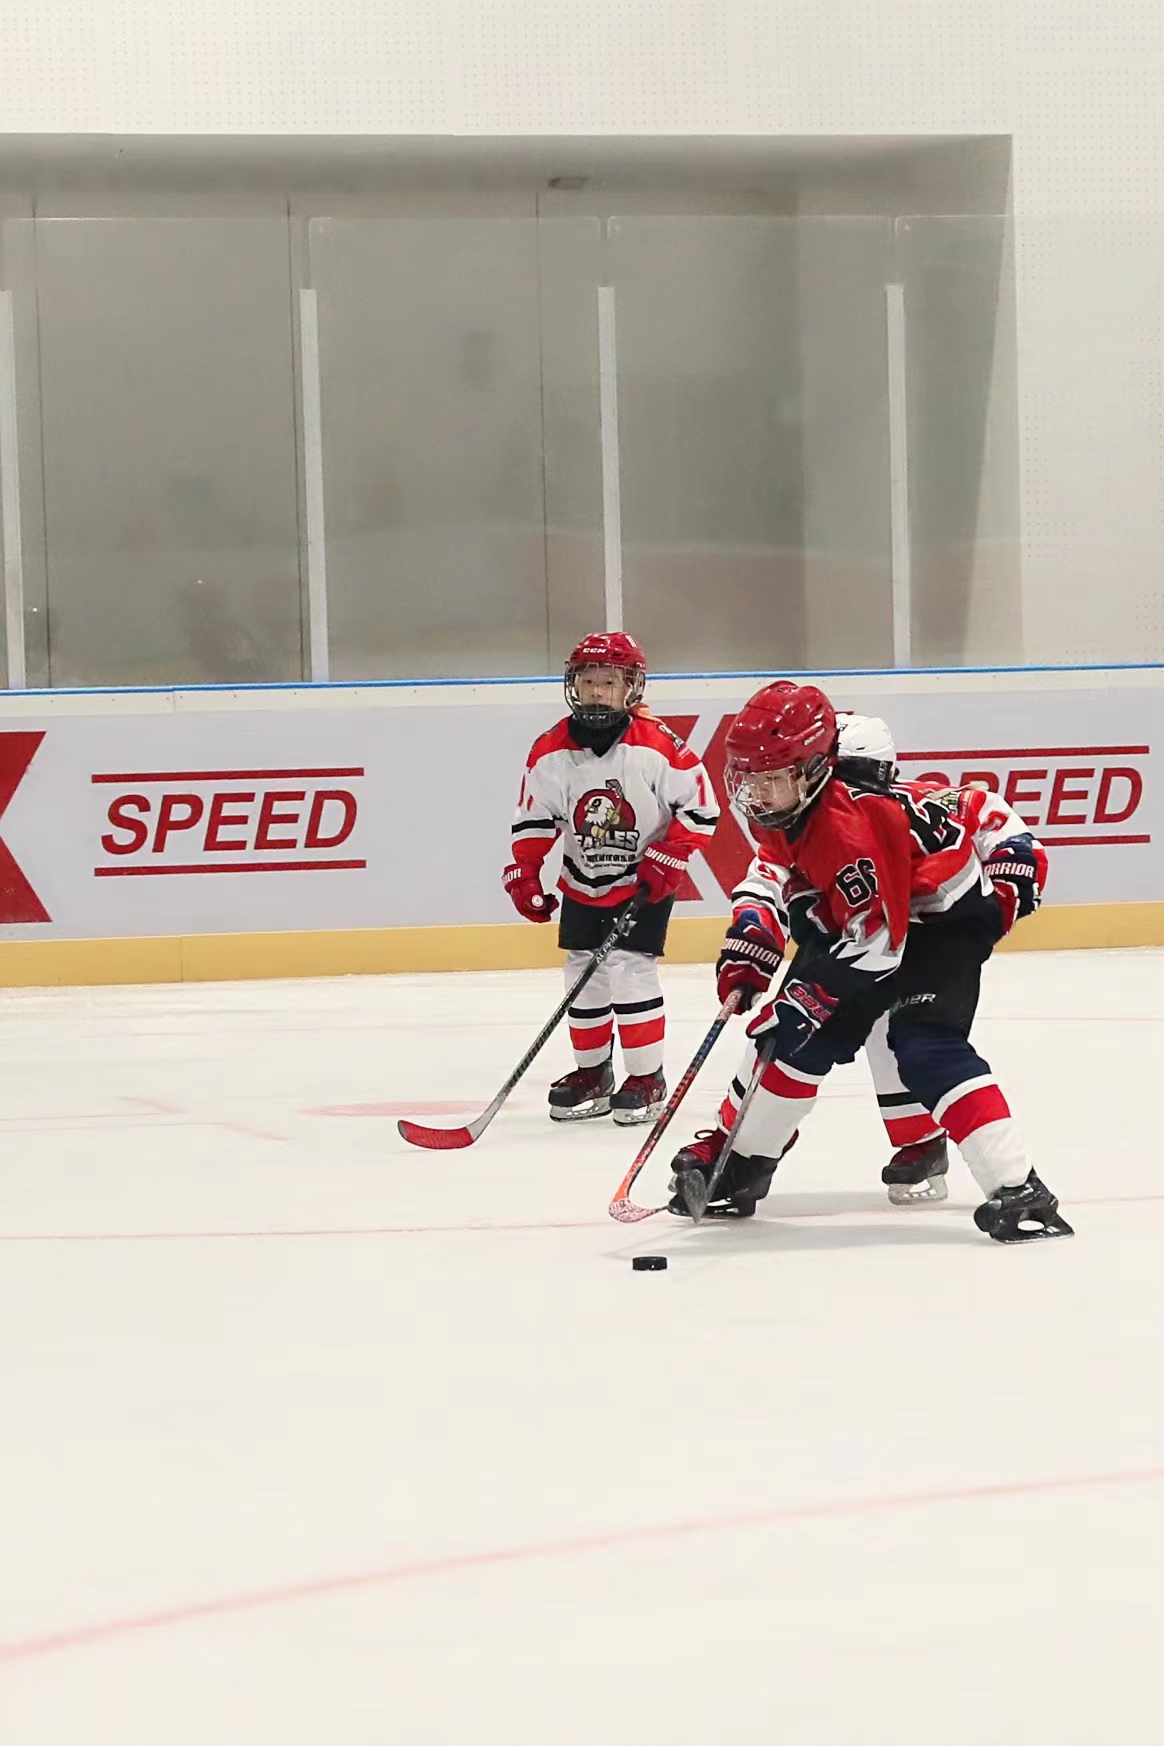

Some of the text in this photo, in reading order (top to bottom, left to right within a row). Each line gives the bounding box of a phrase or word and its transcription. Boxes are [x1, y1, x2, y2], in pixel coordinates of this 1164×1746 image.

[101, 789, 358, 855] SPEED
[916, 767, 1143, 826] EED
[984, 862, 1035, 879] ARRIOR
